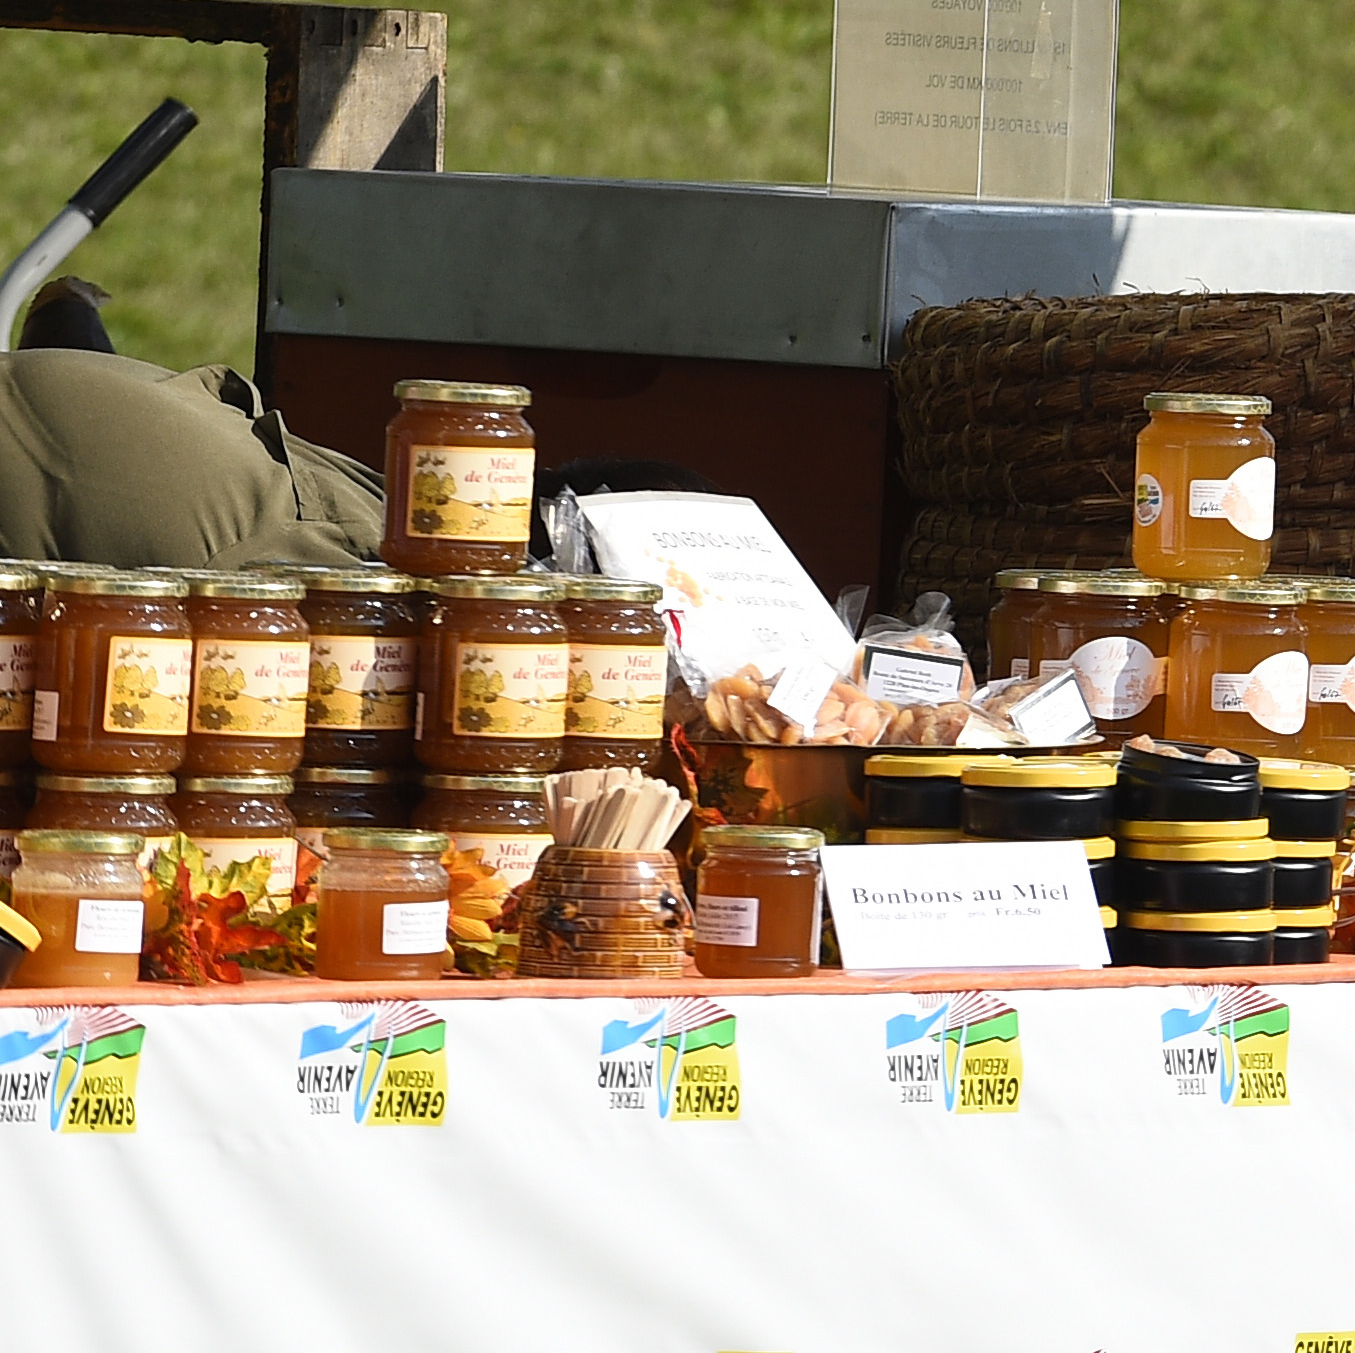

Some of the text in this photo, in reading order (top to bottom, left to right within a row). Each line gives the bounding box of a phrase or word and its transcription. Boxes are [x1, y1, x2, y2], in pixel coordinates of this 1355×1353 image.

[464, 470, 483, 483] de
[254, 665, 273, 678] de
[350, 660, 368, 672] de
[513, 667, 530, 680] de
[601, 667, 620, 681] de
[496, 843, 529, 857] Miel
[852, 883, 1069, 904] Bonbons au Miel
[598, 1060, 654, 1088] AVENIR
[887, 1054, 940, 1082] AVENIR
[1162, 1048, 1217, 1075] AVENIR
[0, 1071, 51, 1101] AVENI
[297, 1065, 357, 1093] AVENIR
[1239, 1072, 1286, 1103] GENÈVE
[374, 1090, 445, 1123] GENÈVE
[676, 1085, 739, 1118] GENÈVE
[901, 1085, 933, 1103] TERRE
[960, 1077, 1019, 1111] GENÈVE
[68, 1096, 135, 1130] GENÈVE
